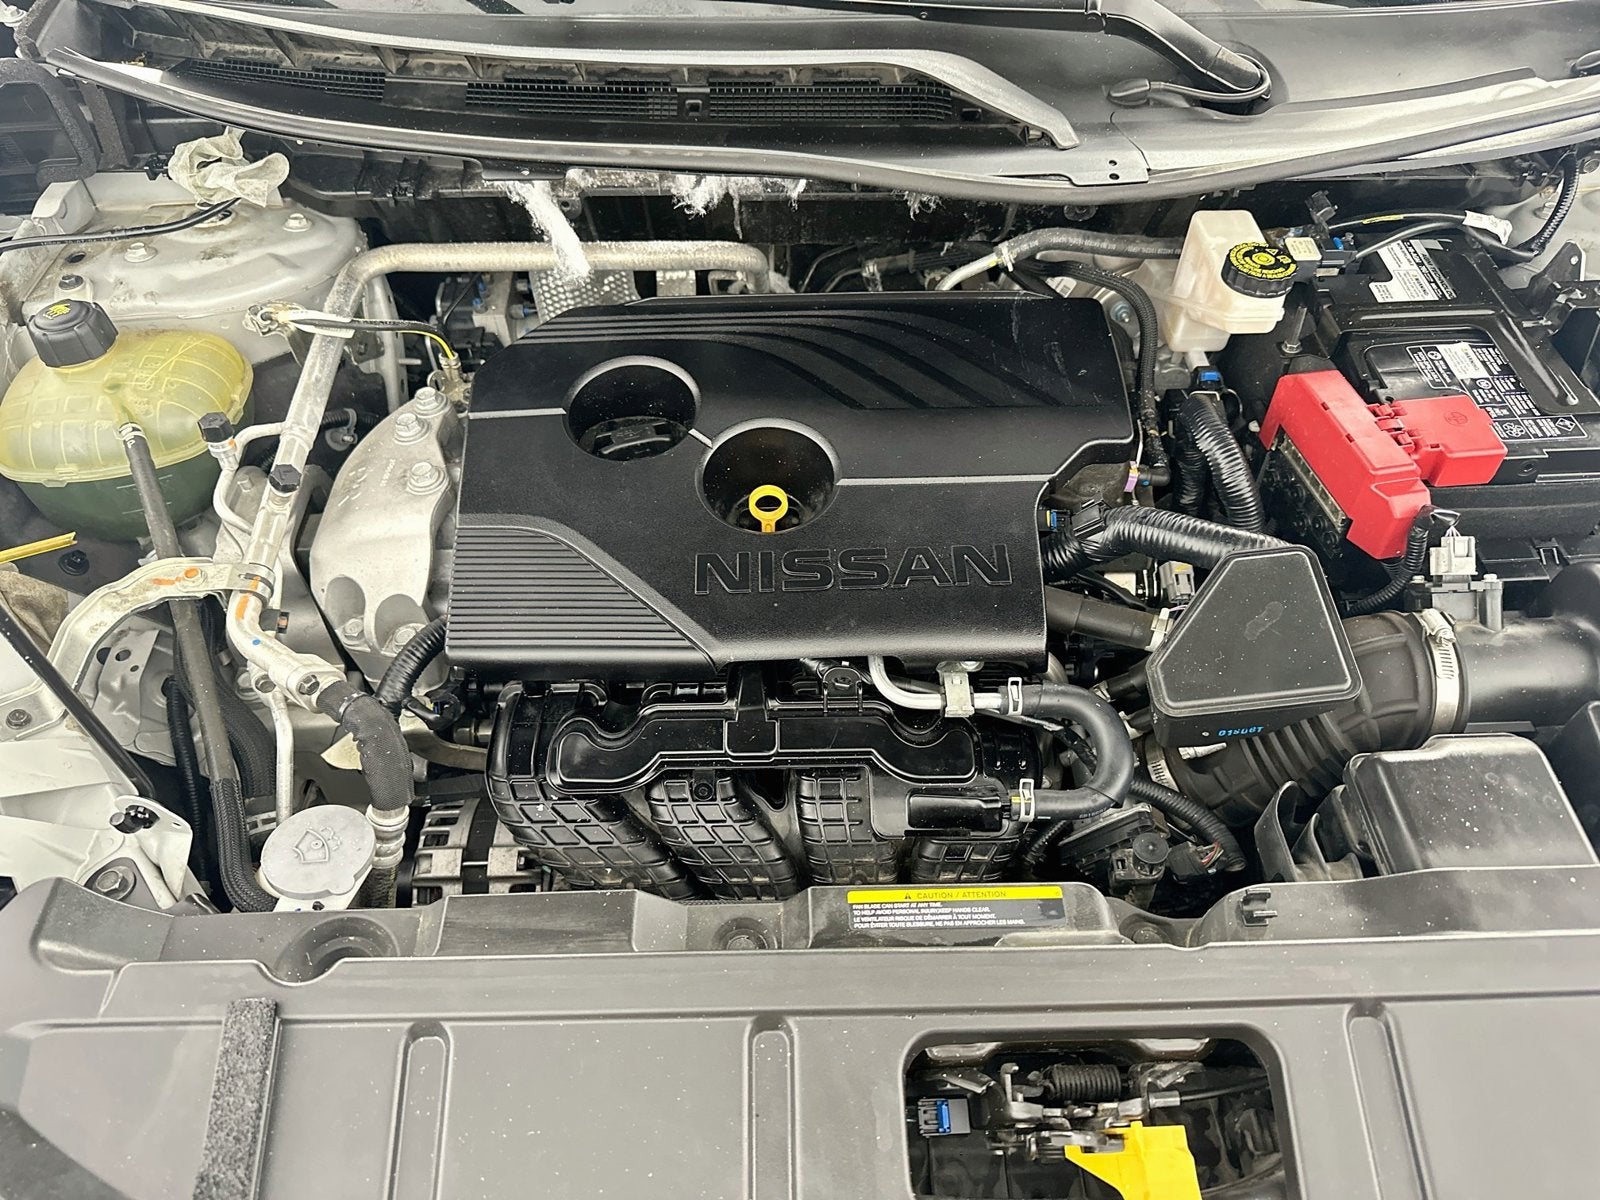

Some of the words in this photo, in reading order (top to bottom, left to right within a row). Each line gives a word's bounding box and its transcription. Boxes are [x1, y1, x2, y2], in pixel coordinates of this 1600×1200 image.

[695, 544, 1012, 595] NISSAN
[916, 892, 953, 900] CAUTION
[961, 890, 1007, 898] ATTENTION
